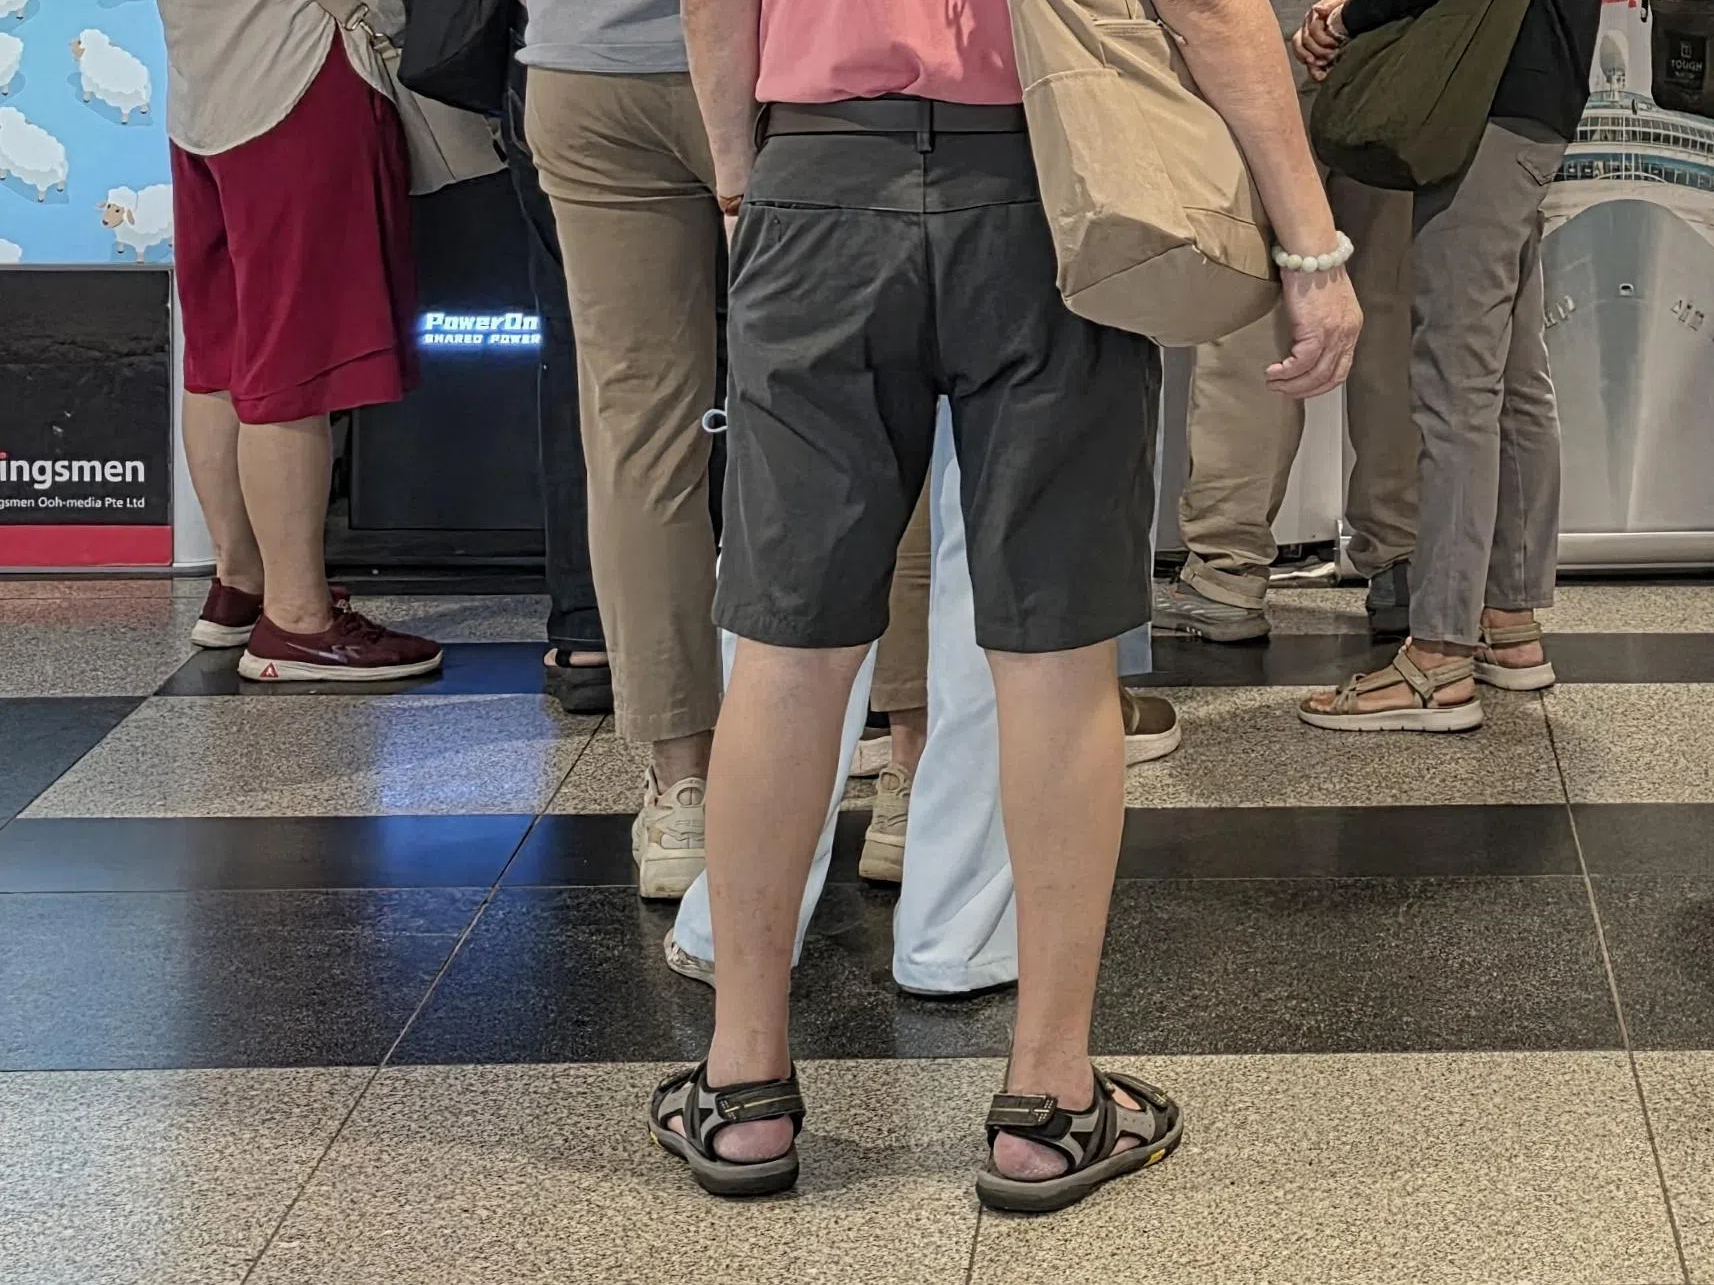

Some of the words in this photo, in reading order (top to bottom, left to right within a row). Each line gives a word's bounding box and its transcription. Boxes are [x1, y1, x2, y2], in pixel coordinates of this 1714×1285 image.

[425, 313, 539, 330] PowerOn
[424, 334, 484, 344] SHARED
[488, 334, 541, 344] POWER
[0, 452, 145, 490] ingsmen
[38, 496, 102, 508] Ooh-media
[105, 497, 123, 508] Pte
[127, 497, 145, 508] Ltd
